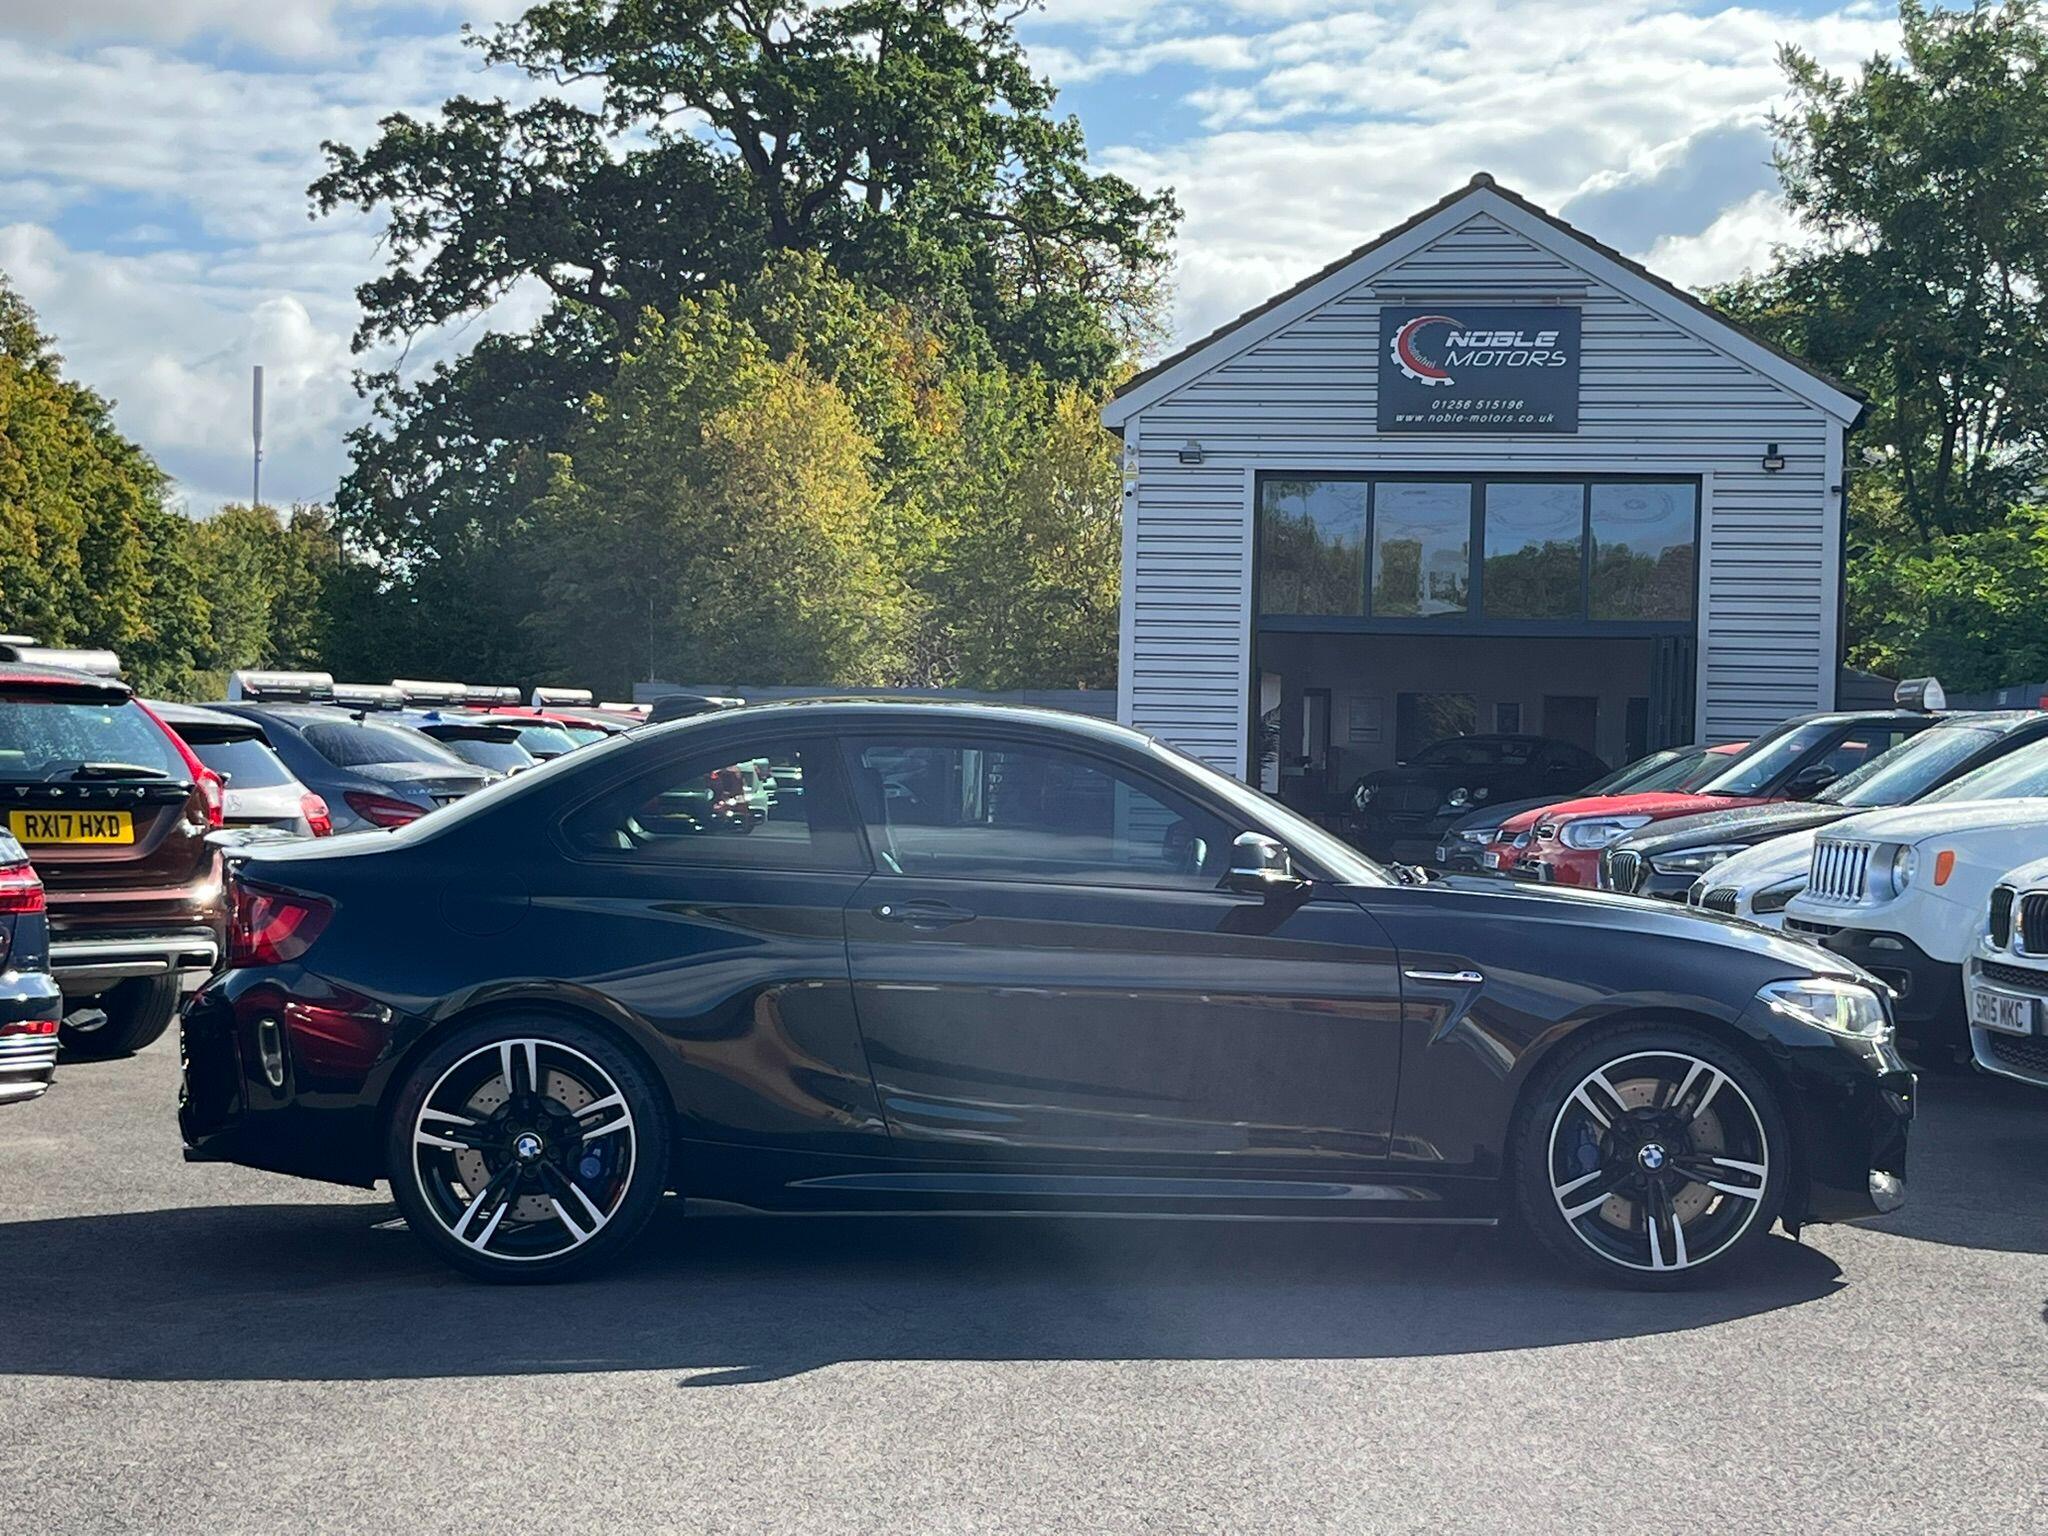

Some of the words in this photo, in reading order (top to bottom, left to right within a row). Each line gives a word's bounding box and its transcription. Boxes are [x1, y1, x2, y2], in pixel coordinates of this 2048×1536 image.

[1445, 331, 1559, 347] NOBLE
[1445, 350, 1567, 367] MOTORS
[1432, 400, 1472, 410] 01256
[1475, 400, 1524, 410] 515196
[25, 815, 73, 838] RX17
[80, 815, 120, 838] HXD
